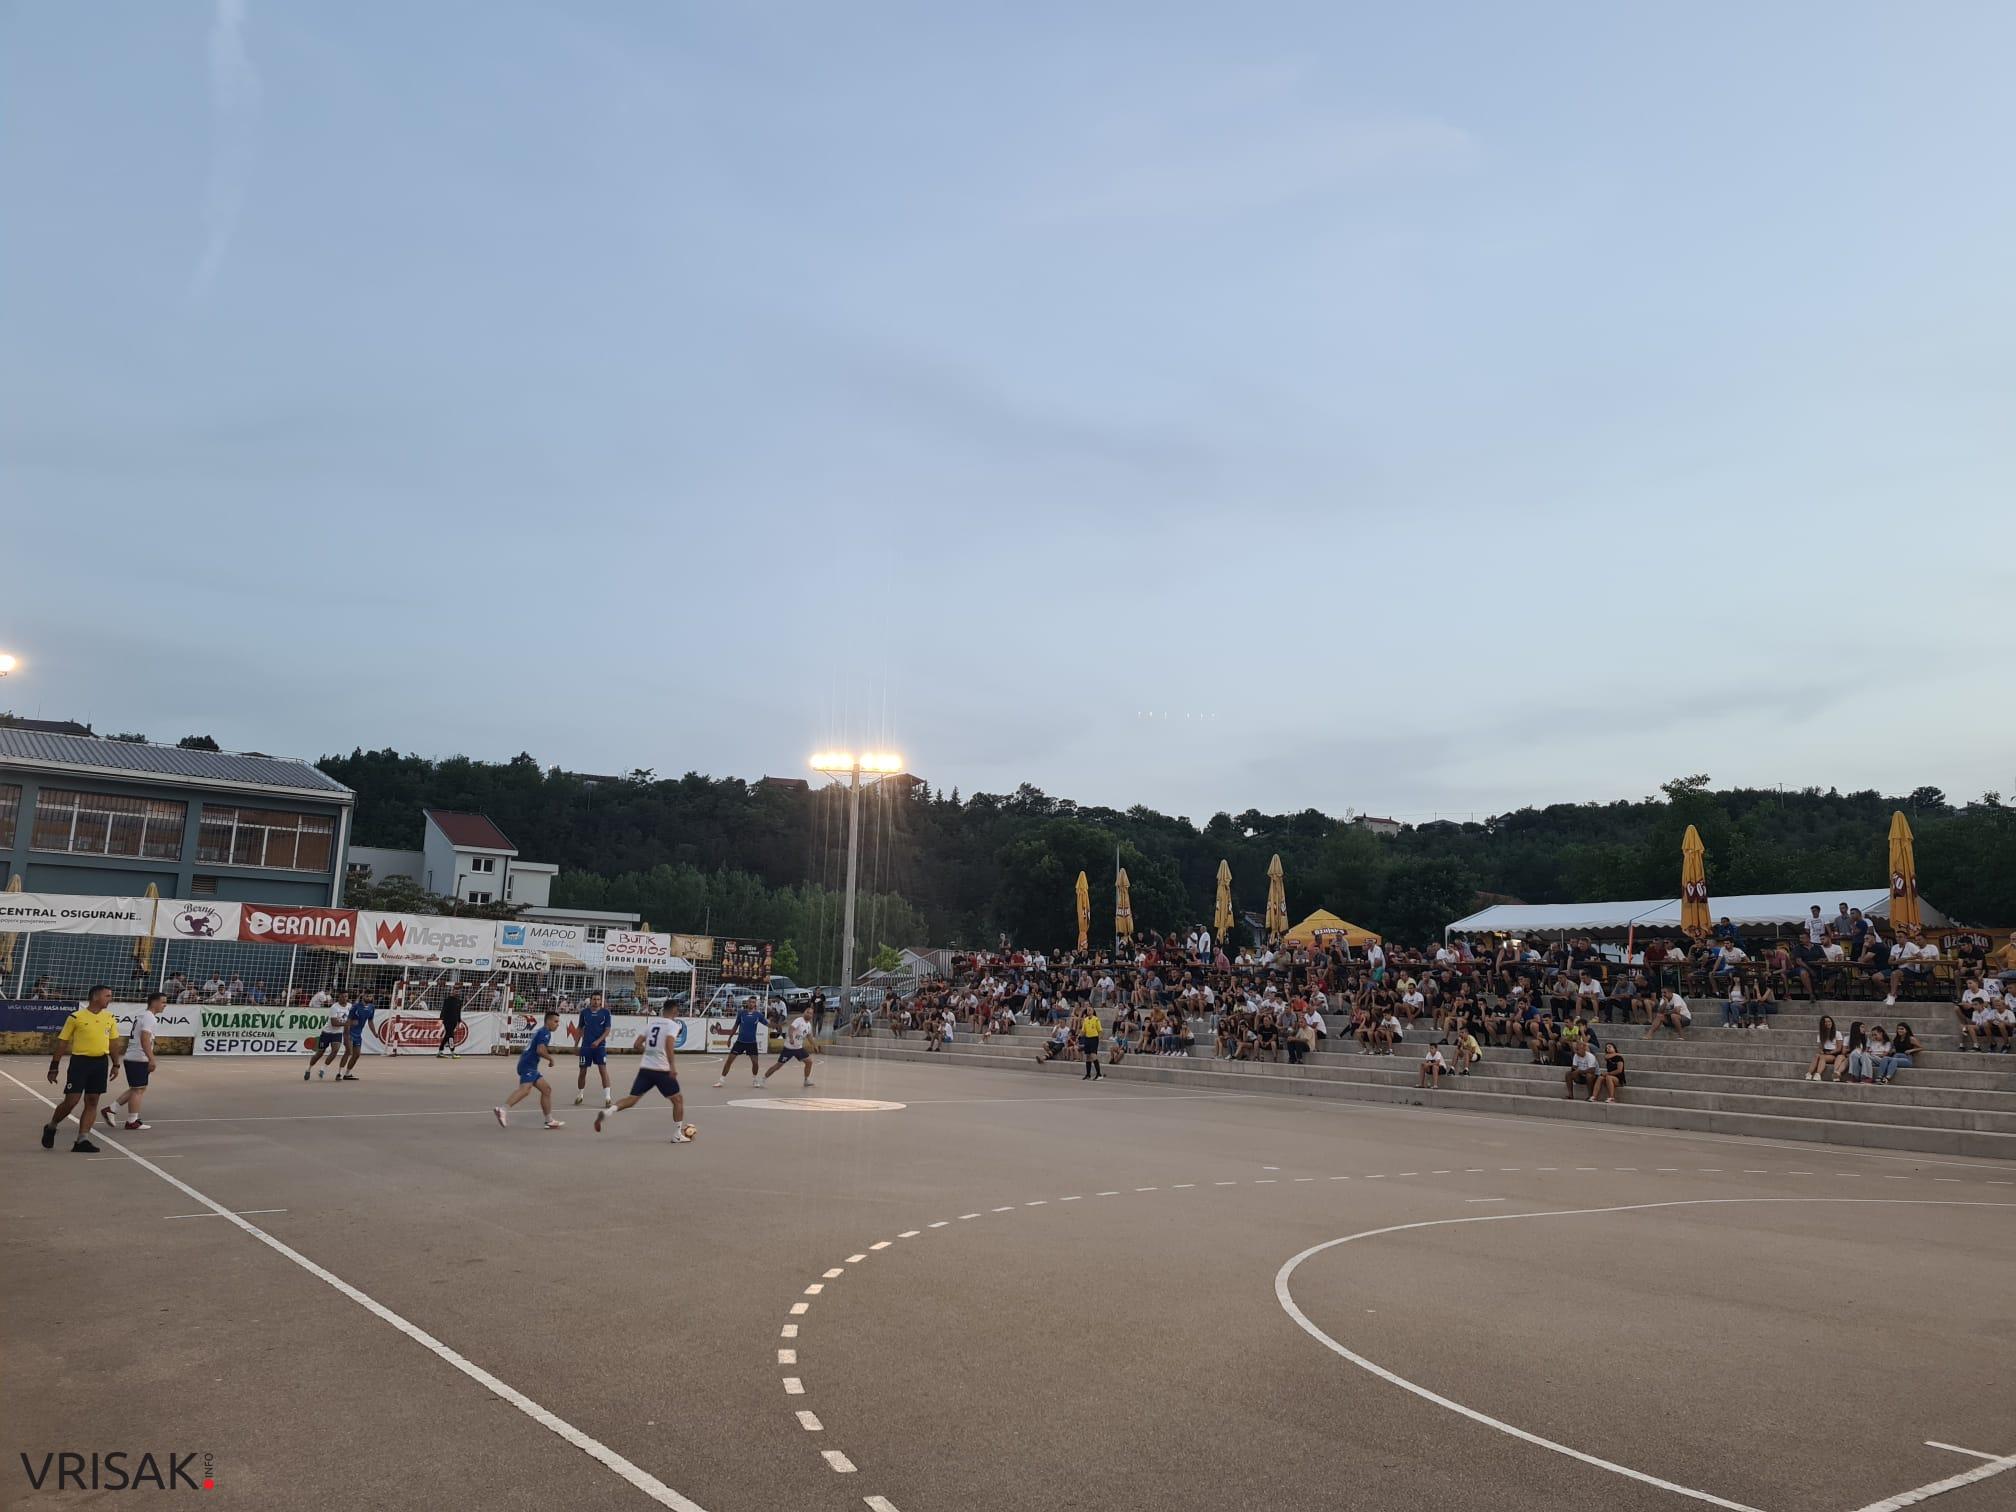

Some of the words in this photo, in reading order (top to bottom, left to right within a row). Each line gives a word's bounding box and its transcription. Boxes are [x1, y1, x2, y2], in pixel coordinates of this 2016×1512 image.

[0, 907, 57, 917] CENTRAL
[60, 909, 136, 920] OSIGURANJE
[406, 926, 478, 951] Mepas
[530, 928, 576, 940] MAPOD
[606, 943, 668, 956] COSMOS
[201, 1010, 285, 1029] VOLAREVIĆ
[649, 1027, 660, 1047] 3
[204, 1039, 298, 1053] SEPTODEZ
